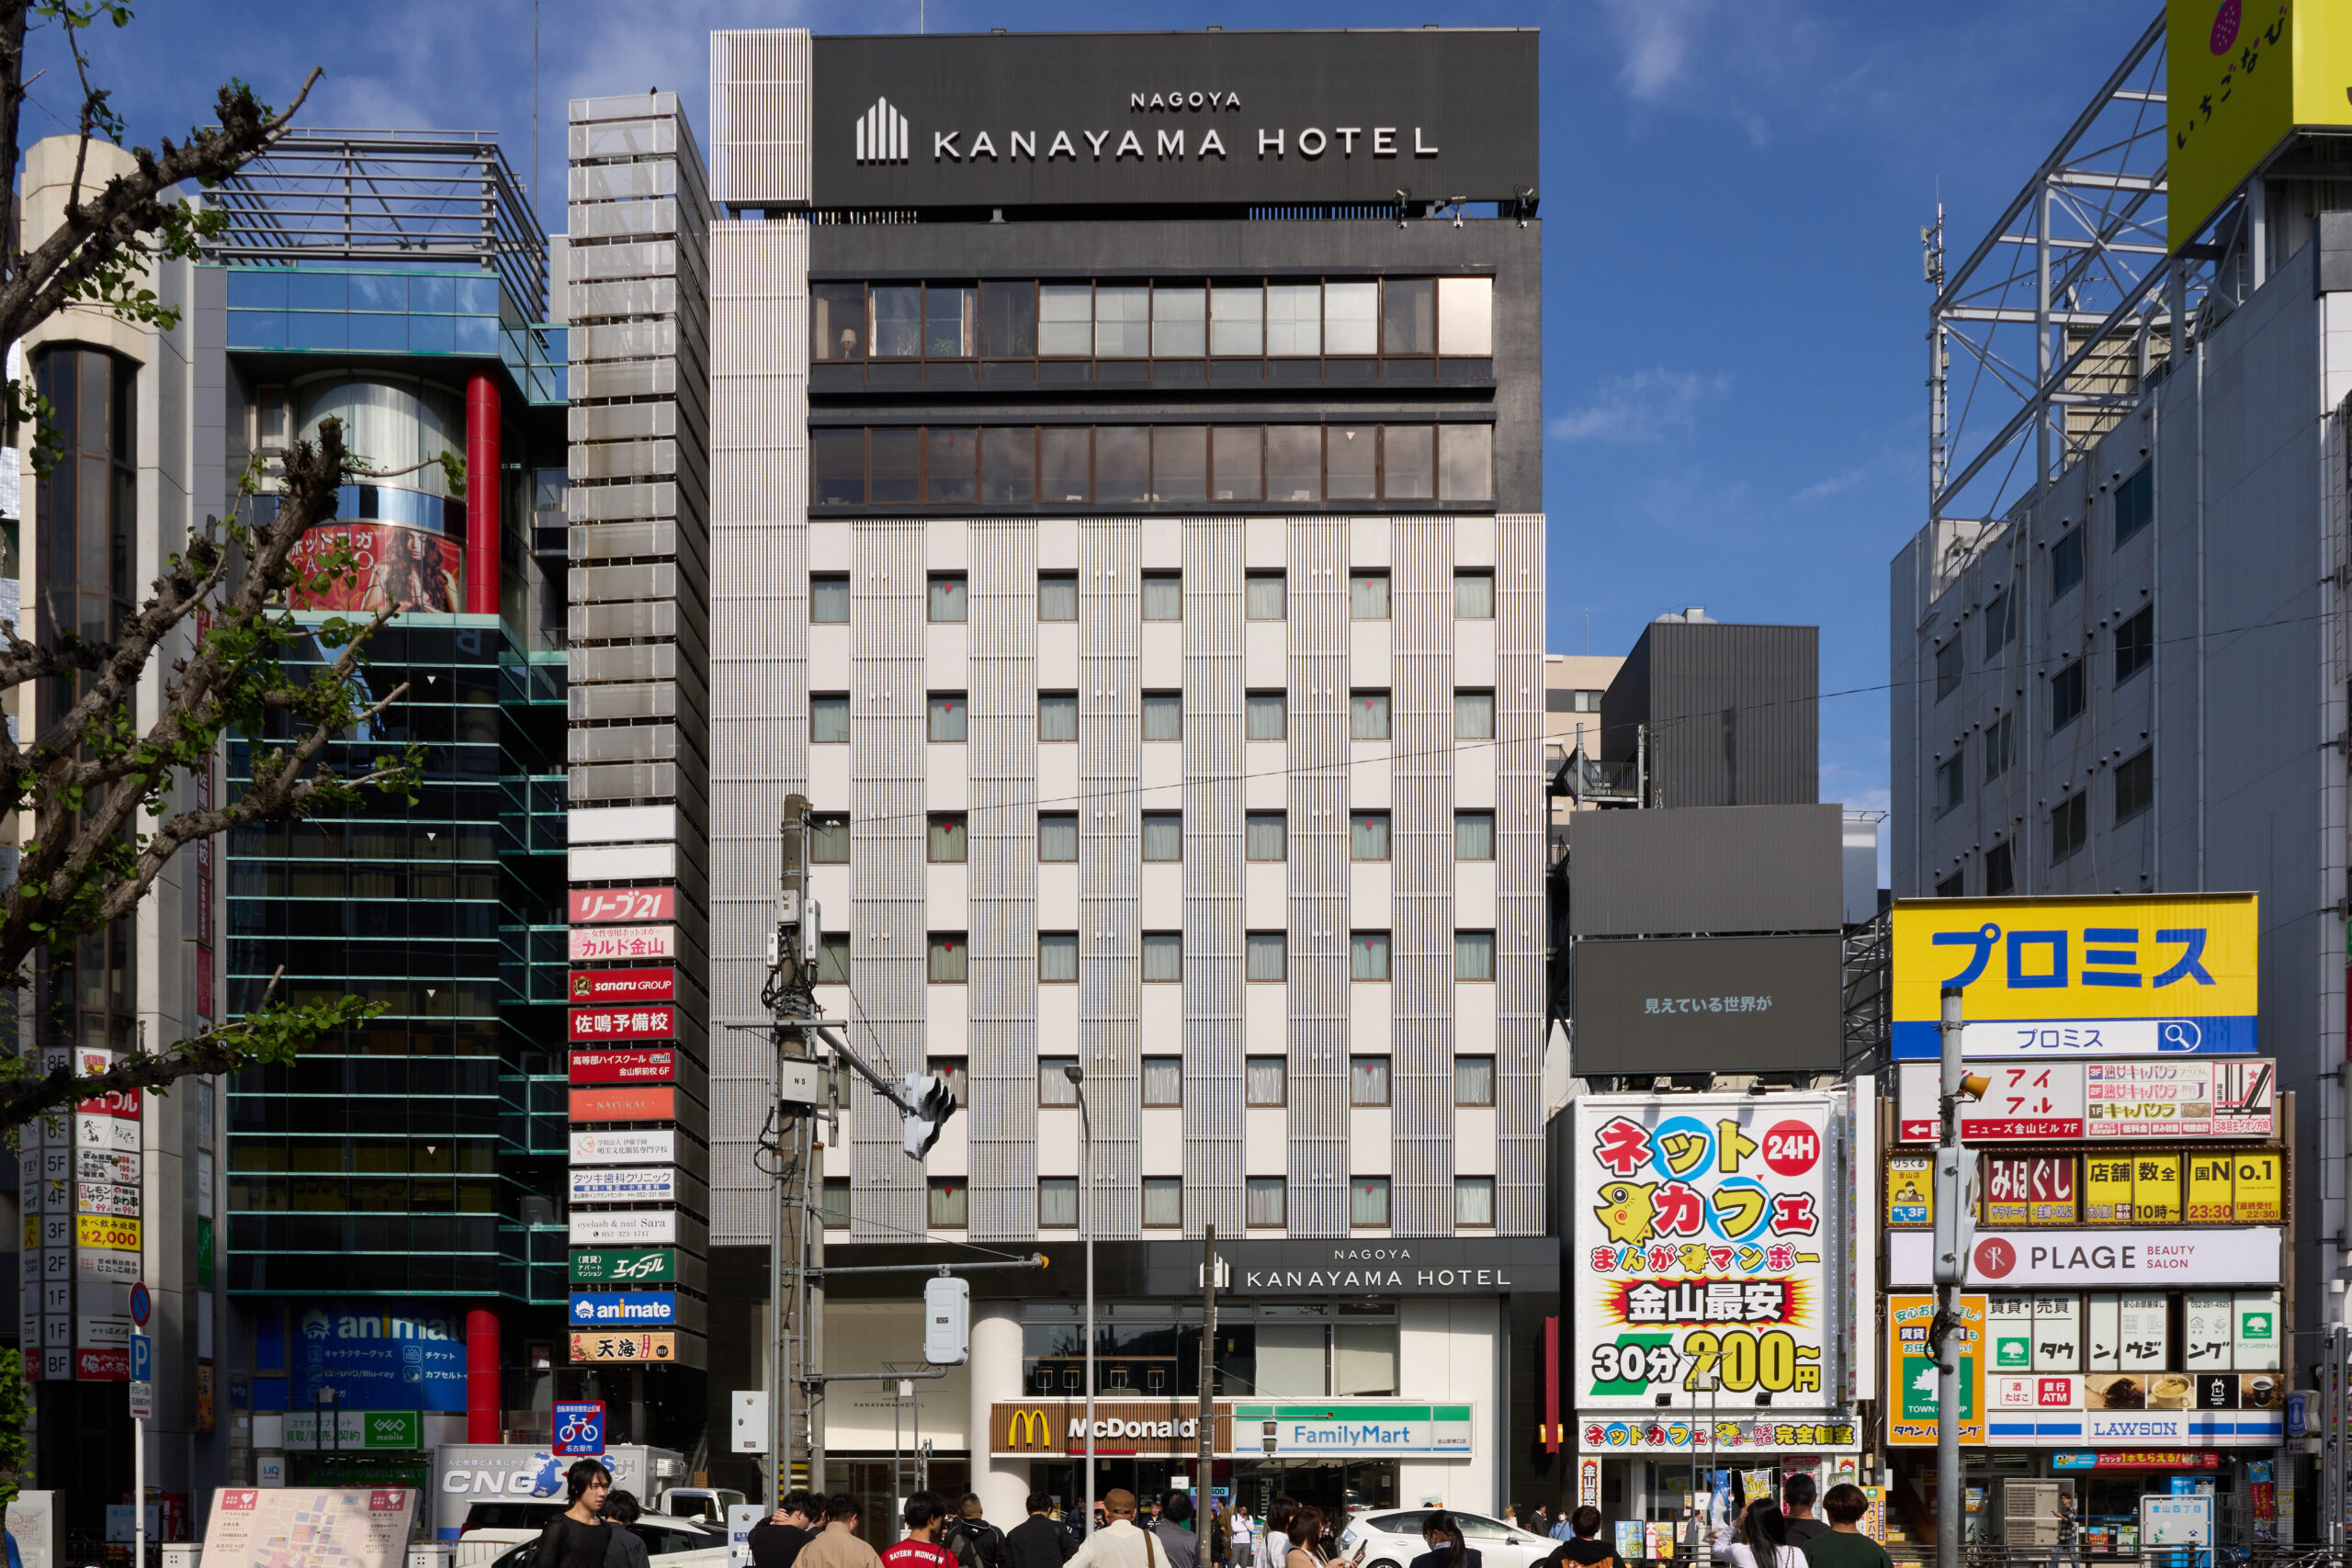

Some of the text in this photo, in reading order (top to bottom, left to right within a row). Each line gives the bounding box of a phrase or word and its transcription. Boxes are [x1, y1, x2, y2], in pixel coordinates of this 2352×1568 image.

[1131, 92, 1241, 110] NAGOYA
[933, 127, 1440, 159] KANAYAMA HOTEL
[582, 891, 662, 919] リーブ21
[592, 928, 654, 937] 女性専用ホットヨガ
[582, 937, 664, 956] カルド金山
[1932, 922, 2217, 989] プロミス
[594, 980, 672, 991] sanaru GROUP
[1645, 996, 1772, 1014] 見えている世界が
[575, 1013, 669, 1033] 佐鳴予備校
[2017, 1029, 2103, 1049] プロミス
[572, 1055, 647, 1066] 高等部ハイスクール
[619, 1066, 670, 1077] 金山駅前校 6F
[2104, 1066, 2177, 1080] 熟女キャバクラ
[2104, 1084, 2177, 1100] 熟女キャバクラ
[2090, 1107, 2102, 1116] 1F
[2104, 1103, 2177, 1119] キャバクラ
[1969, 1123, 2077, 1134] ニューズ金山ビル 7F
[1593, 1115, 1759, 1178] ネット
[1768, 1135, 1815, 1159] 24H
[48, 1156, 65, 1171] 5F
[1894, 1158, 1925, 1168] りらくる
[573, 1172, 672, 1184] タツキ歯科クリニック
[1975, 1157, 2071, 1201] みほぐし
[48, 1190, 65, 1205] 4F
[1651, 1179, 1820, 1237] カフェ
[1908, 1207, 1925, 1217] 3F
[2189, 1204, 2233, 1219] 23:30
[48, 1223, 66, 1238] 3F
[81, 1218, 137, 1231] 食べ飲み放題
[577, 1218, 666, 1229] eyelash & nail Sara
[81, 1230, 137, 1246] ¥2,000
[1334, 1249, 1411, 1259] NAGOYA
[1590, 1244, 1820, 1271] まんが マンボー
[2030, 1246, 2135, 1269] PLAGE
[2147, 1246, 2196, 1255] BEAUTY
[48, 1257, 66, 1271] 2F
[578, 1255, 603, 1264] (賃貸)
[2147, 1259, 2189, 1269] SALON
[612, 1256, 665, 1279] エイブル
[1247, 1269, 1511, 1287] KANAYAMA HOTEL
[49, 1291, 66, 1305] 1F
[1626, 1281, 1785, 1324] 金山最安
[597, 1298, 672, 1318] animate
[49, 1324, 66, 1338] 1F
[337, 1306, 467, 1341] animat
[324, 1349, 456, 1360] キャラクターグッズ チケット
[597, 1338, 637, 1358] 天海
[48, 1357, 66, 1372] BF
[135, 1338, 148, 1376] P
[1592, 1343, 1680, 1382] 30分
[2012, 1382, 2021, 1392] 酒
[2044, 1382, 2065, 1392] 銀行
[2005, 1393, 2029, 1402] たばこ
[2041, 1393, 2067, 1402] ATM
[374, 1418, 406, 1431] GEO
[2094, 1423, 2177, 1436] LAWSON
[1294, 1425, 1410, 1446] FamilyMart
[1774, 1425, 1856, 1447] 完全個室
[442, 1470, 537, 1495] CNG
[2153, 1505, 2202, 1514] 金山四丁目
[889, 1550, 912, 1561] BAYERN
